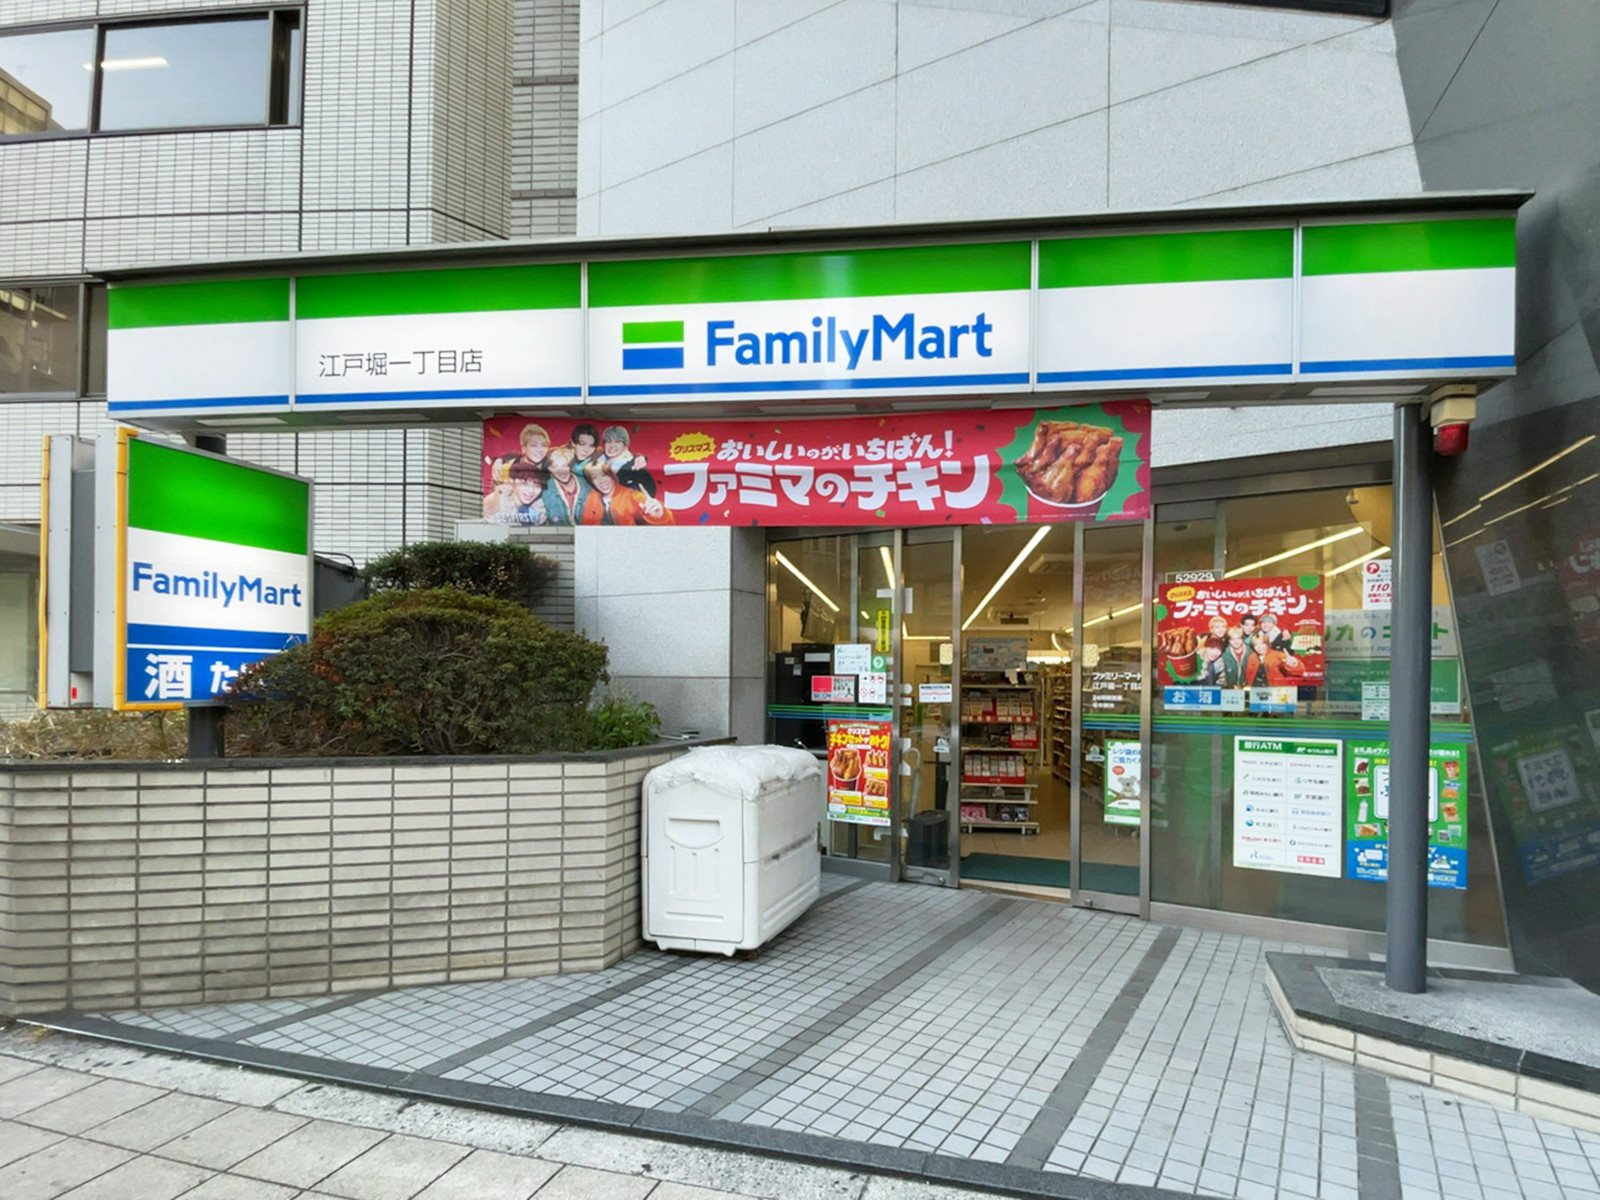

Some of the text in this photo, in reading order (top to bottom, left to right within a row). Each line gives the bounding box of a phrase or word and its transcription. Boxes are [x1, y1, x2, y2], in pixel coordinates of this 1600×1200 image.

[706, 312, 993, 371] FamilyMart
[319, 348, 483, 377] 江戸堀一丁目店
[673, 441, 713, 455] クリスマス
[663, 453, 990, 511] ファミマのチキン
[132, 561, 302, 608] FamilyMart
[1175, 571, 1213, 584] 52929
[1370, 583, 1392, 592] 110
[1173, 595, 1307, 619] ファミマのチキン
[144, 652, 193, 699] 酒
